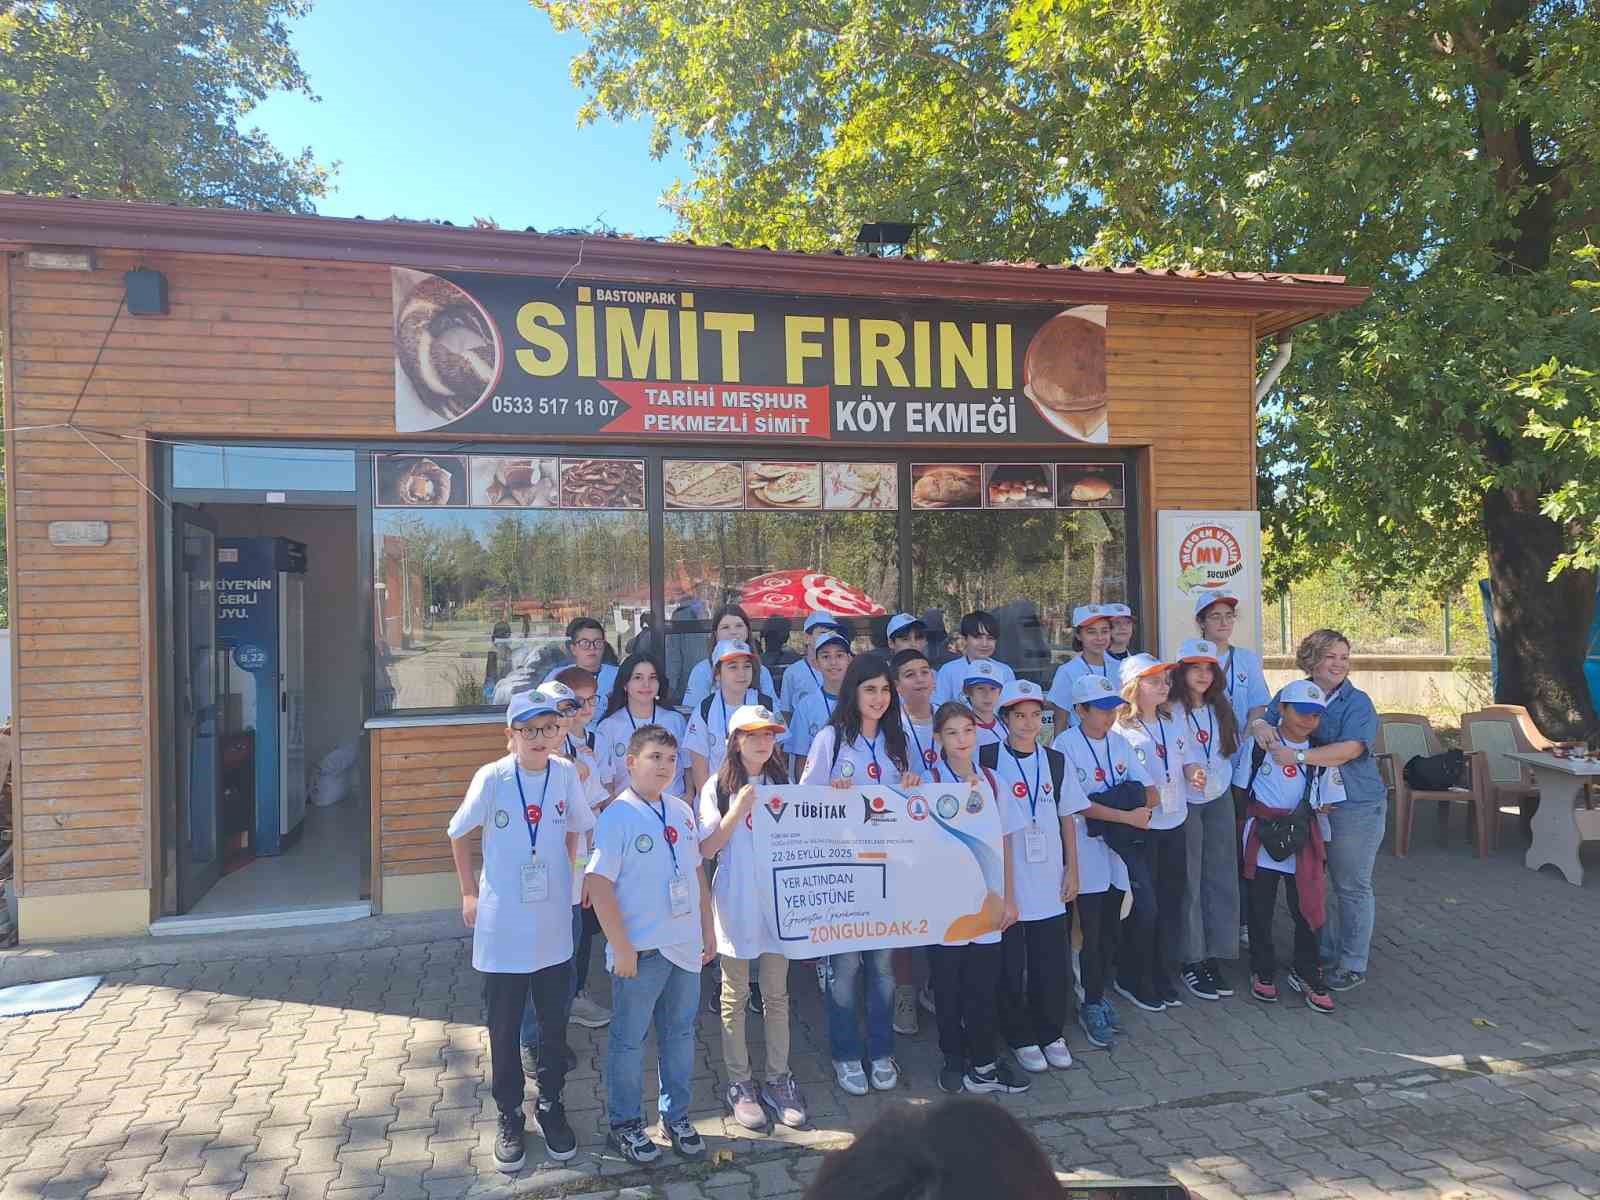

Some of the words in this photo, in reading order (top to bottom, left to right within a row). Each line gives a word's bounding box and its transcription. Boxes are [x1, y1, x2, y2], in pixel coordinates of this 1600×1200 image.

[596, 288, 676, 306] BASTONPARK
[515, 286, 756, 382] SİMİT
[785, 315, 1013, 390] FIRINI
[492, 396, 533, 415] 0533
[538, 397, 569, 416] 517
[575, 398, 594, 417] 18
[598, 399, 619, 418] 07
[644, 386, 715, 408] TARİHİ
[721, 390, 808, 415] MEŞHUR
[643, 411, 749, 434] PEKMEZLİ
[755, 412, 810, 434] SİMİT
[836, 393, 895, 433] KÖY
[905, 396, 1017, 435] EKMEĞİ
[218, 592, 256, 604] ĞERLİ
[794, 803, 847, 819] TÜBİTAK
[829, 848, 853, 858] 2025
[782, 875, 800, 889] YER
[803, 872, 853, 887] ALTINDAN
[784, 892, 806, 908] YER
[808, 889, 855, 906] ÜSTÜNE
[810, 919, 929, 944] ZONGULDAK-2
